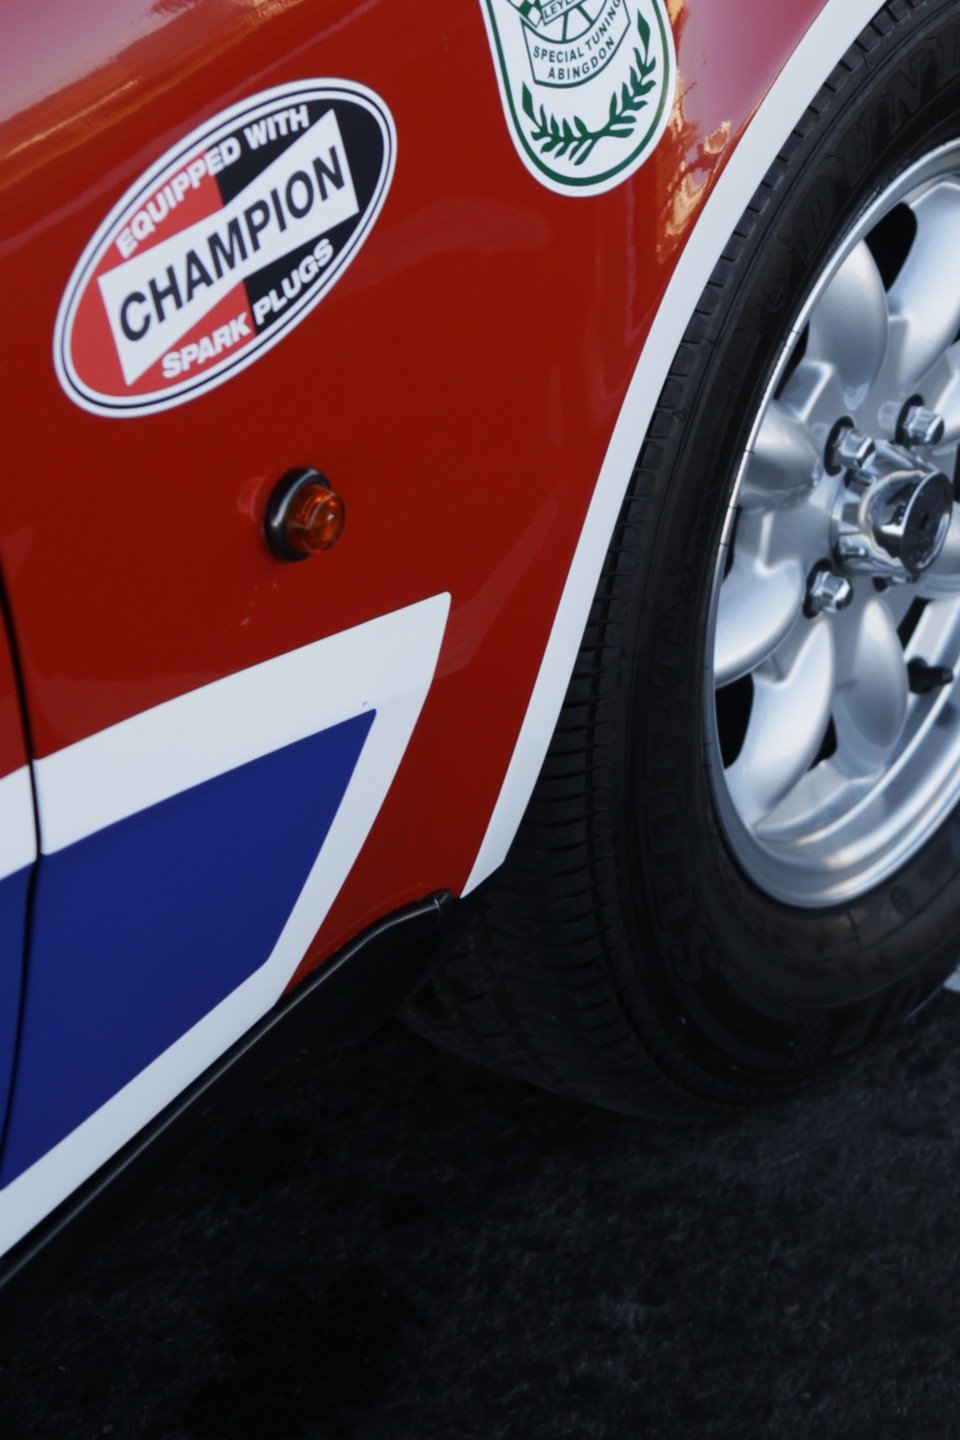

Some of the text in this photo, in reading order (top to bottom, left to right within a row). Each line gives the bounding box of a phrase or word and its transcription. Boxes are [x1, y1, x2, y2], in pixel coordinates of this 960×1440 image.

[533, 45, 584, 63] SPECIAL
[548, 36, 615, 80] ABINGDON
[114, 104, 310, 259] EQUIPPED WITH
[119, 145, 346, 342] CHAMPION
[161, 237, 334, 379] SPARK PLUGS
